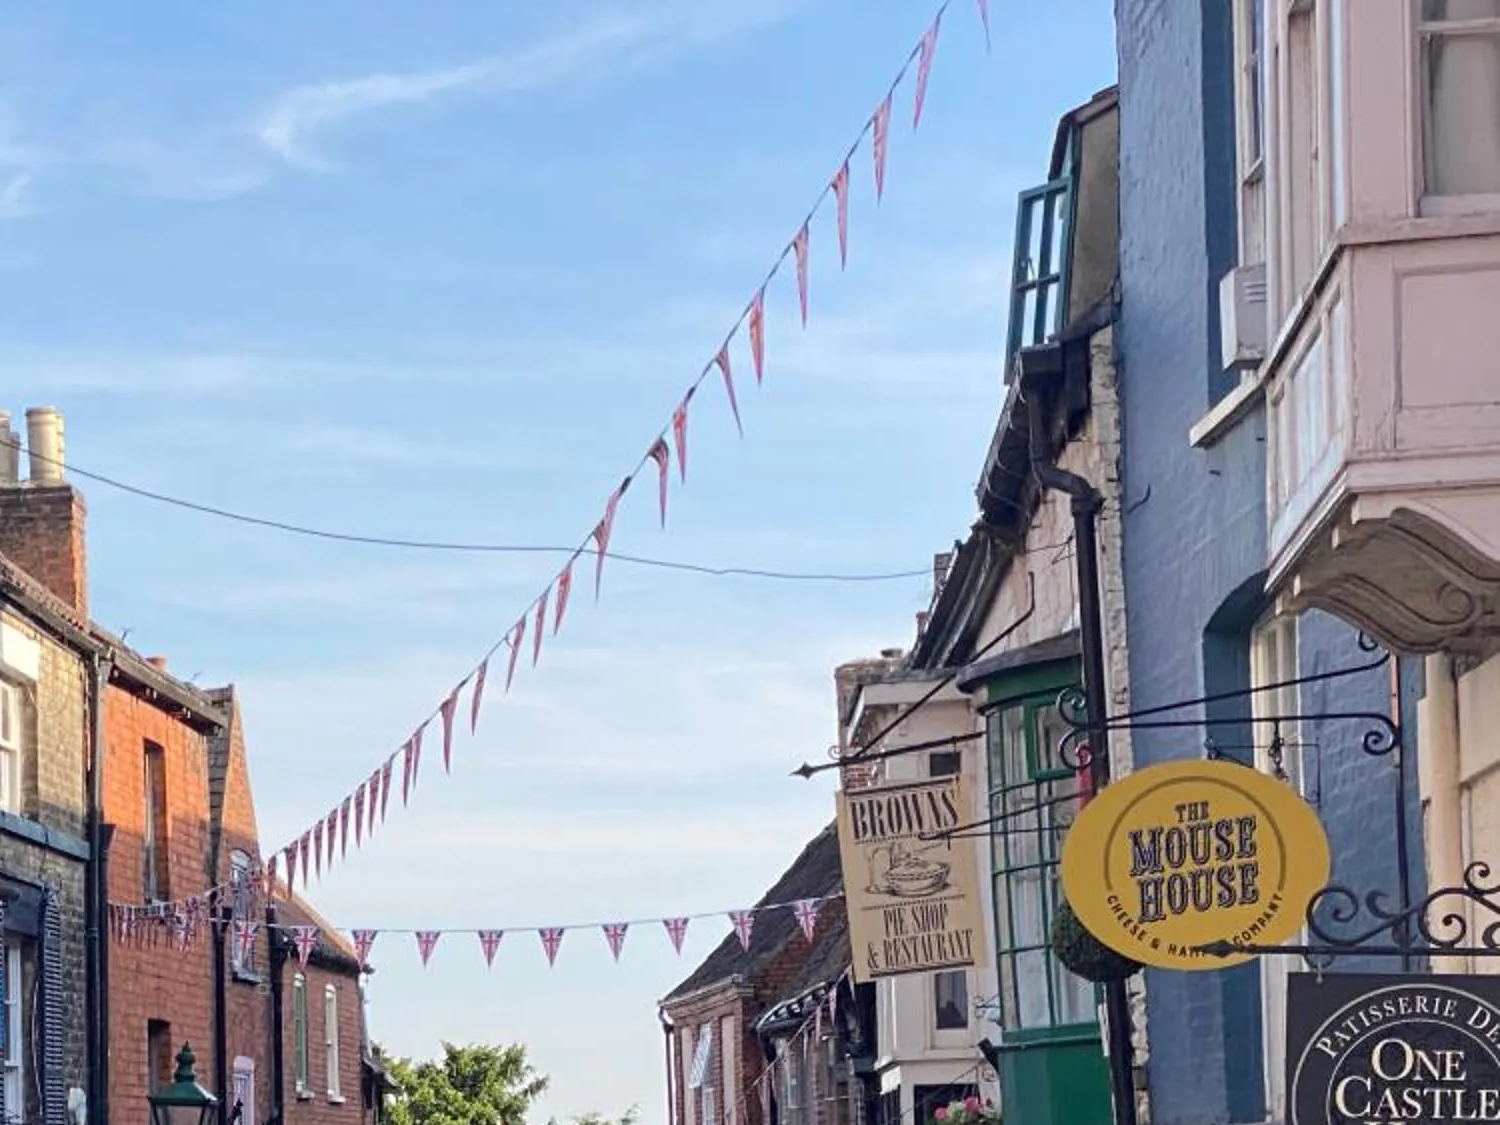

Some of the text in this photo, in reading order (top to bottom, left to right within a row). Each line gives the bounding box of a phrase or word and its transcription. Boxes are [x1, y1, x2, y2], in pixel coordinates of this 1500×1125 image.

[851, 788, 958, 840] BROWNS
[1174, 801, 1210, 823] THE
[1128, 816, 1258, 878] MOUSE
[1137, 862, 1260, 924] HOUSE
[884, 903, 950, 938] PIE SHOP
[1107, 894, 1149, 943] CHEESE
[1233, 892, 1285, 947] COMPANY
[867, 929, 973, 970] & RESTAURANT
[1316, 996, 1457, 1058] PATISSERIE
[1372, 1038, 1467, 1081] ONE
